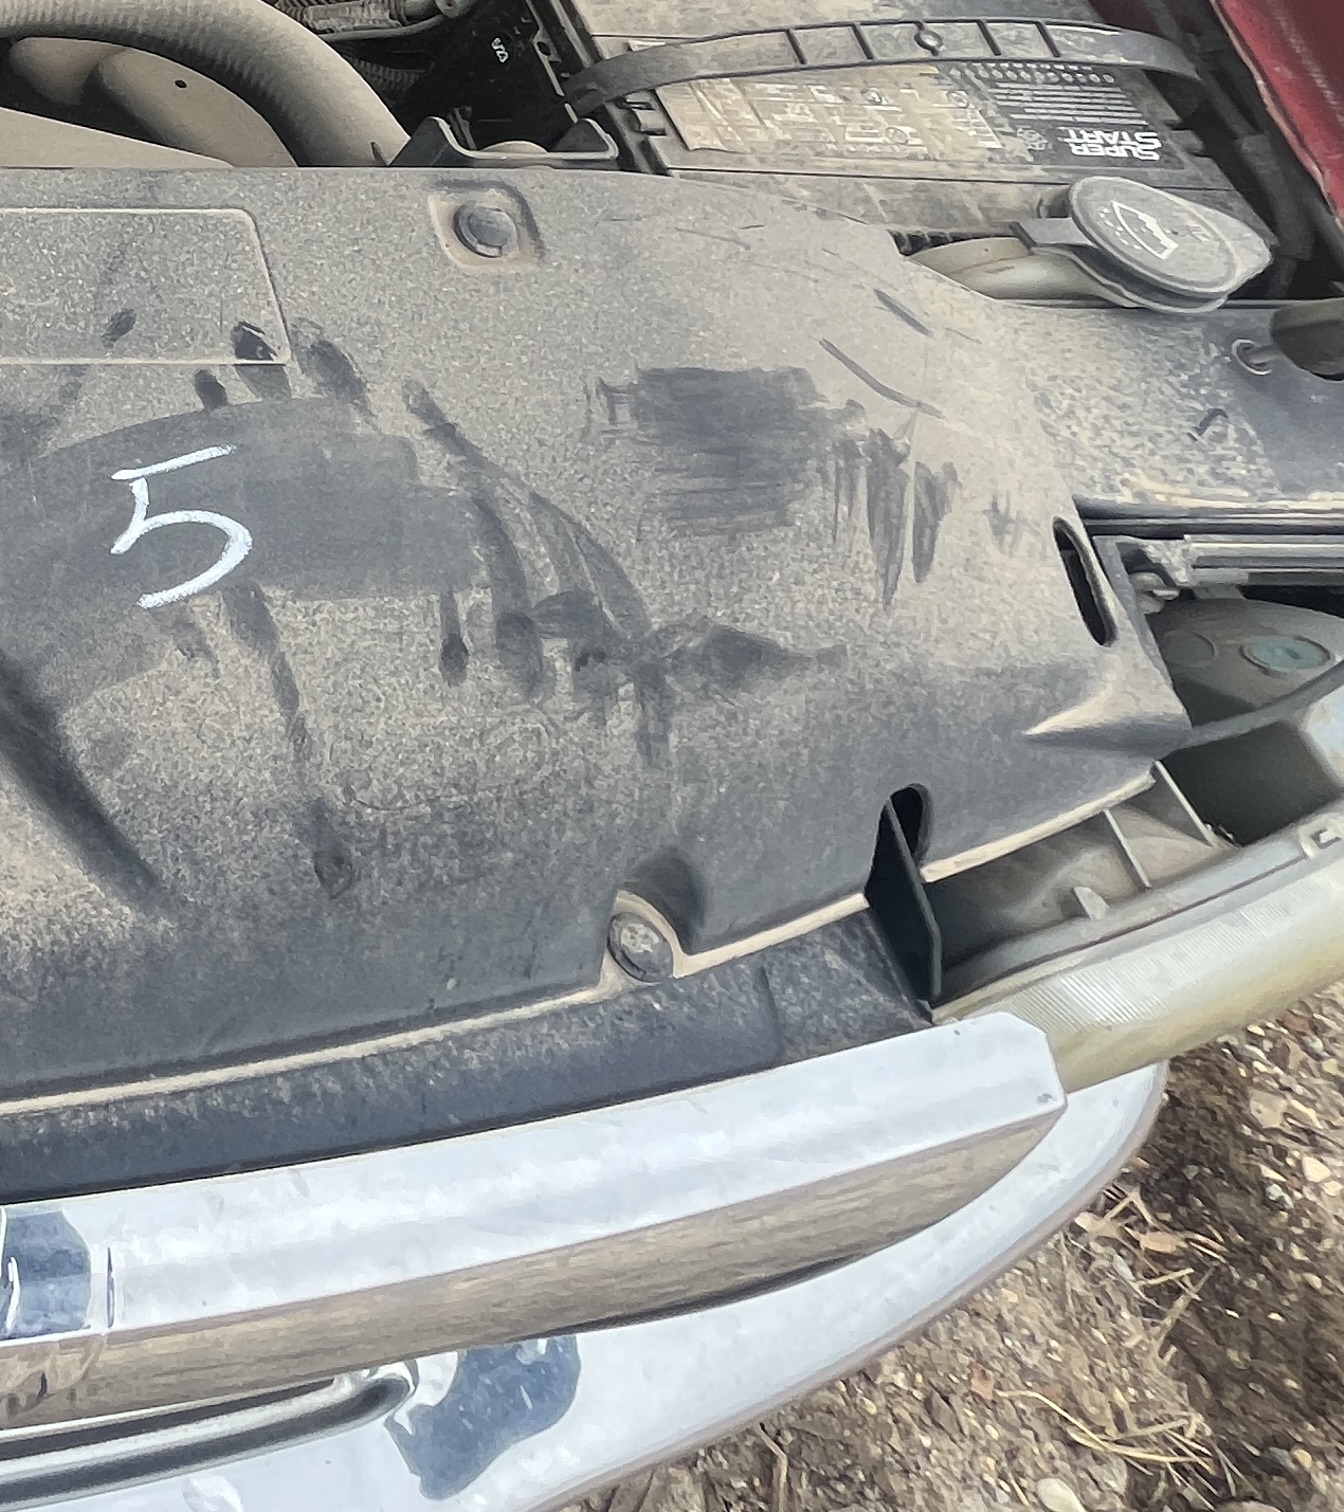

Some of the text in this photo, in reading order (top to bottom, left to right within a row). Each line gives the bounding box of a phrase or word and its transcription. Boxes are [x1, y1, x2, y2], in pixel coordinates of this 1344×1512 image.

[1063, 129, 1162, 148] START
[1069, 143, 1160, 161] SUPER
[110, 443, 253, 609] 5
